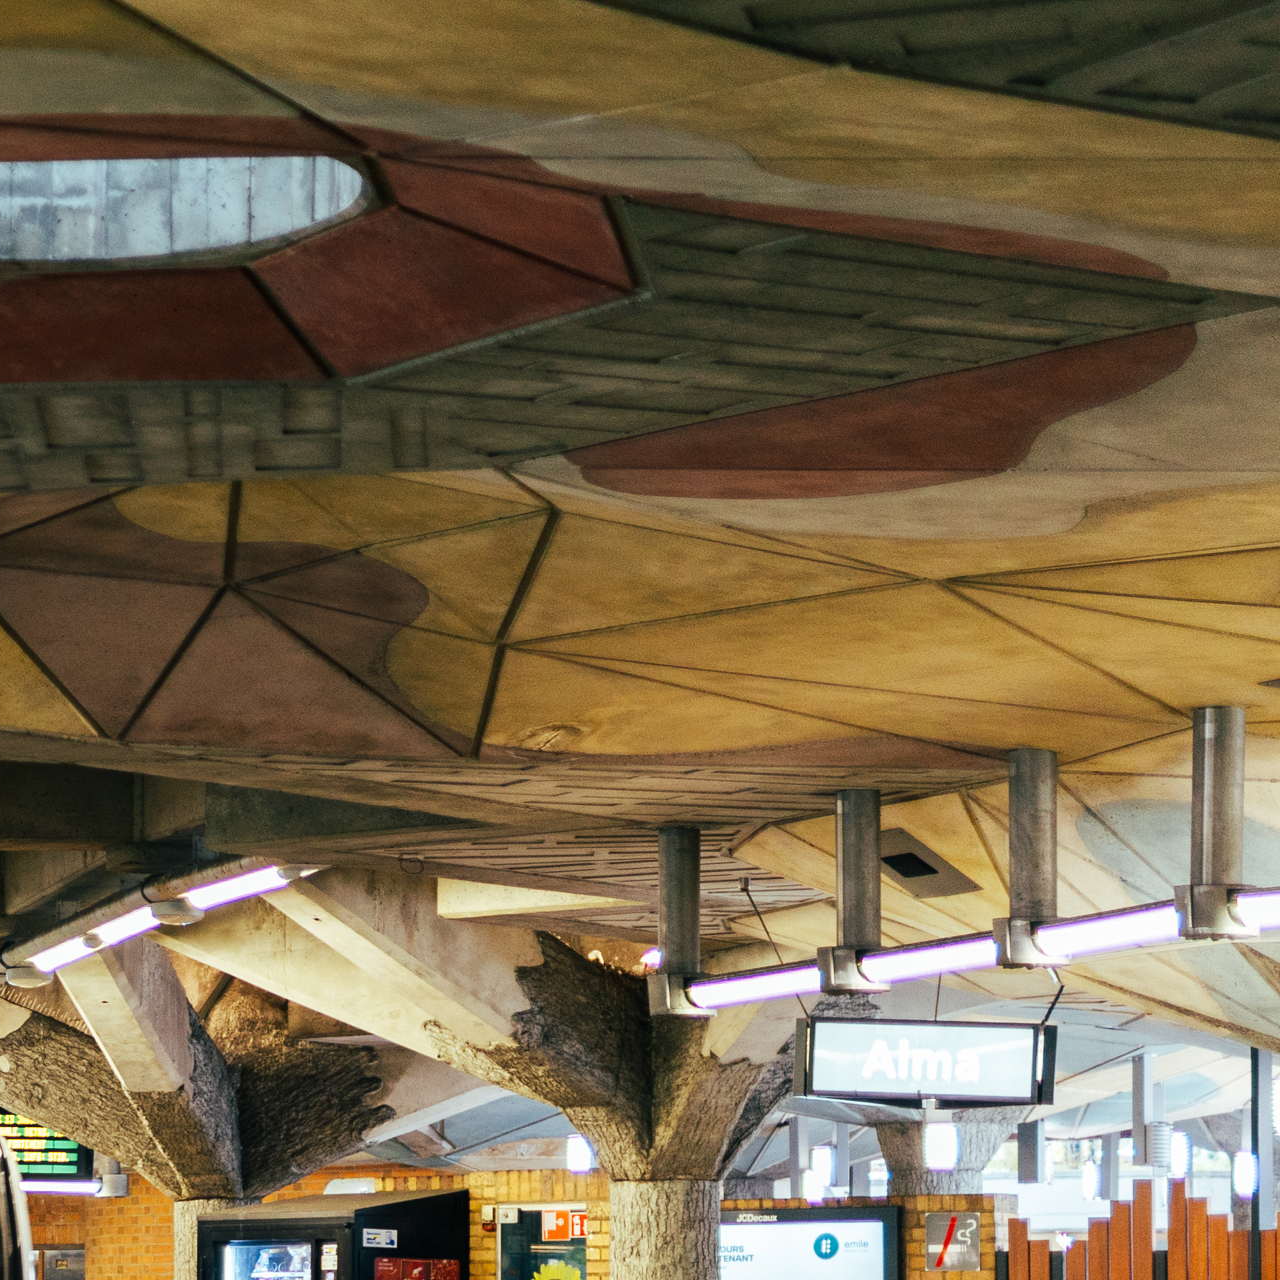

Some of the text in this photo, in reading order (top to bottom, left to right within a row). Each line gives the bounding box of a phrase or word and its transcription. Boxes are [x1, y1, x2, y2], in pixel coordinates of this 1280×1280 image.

[861, 1037, 981, 1082] Alma
[736, 1213, 778, 1223] JCDecaux
[844, 1239, 870, 1249] emile
